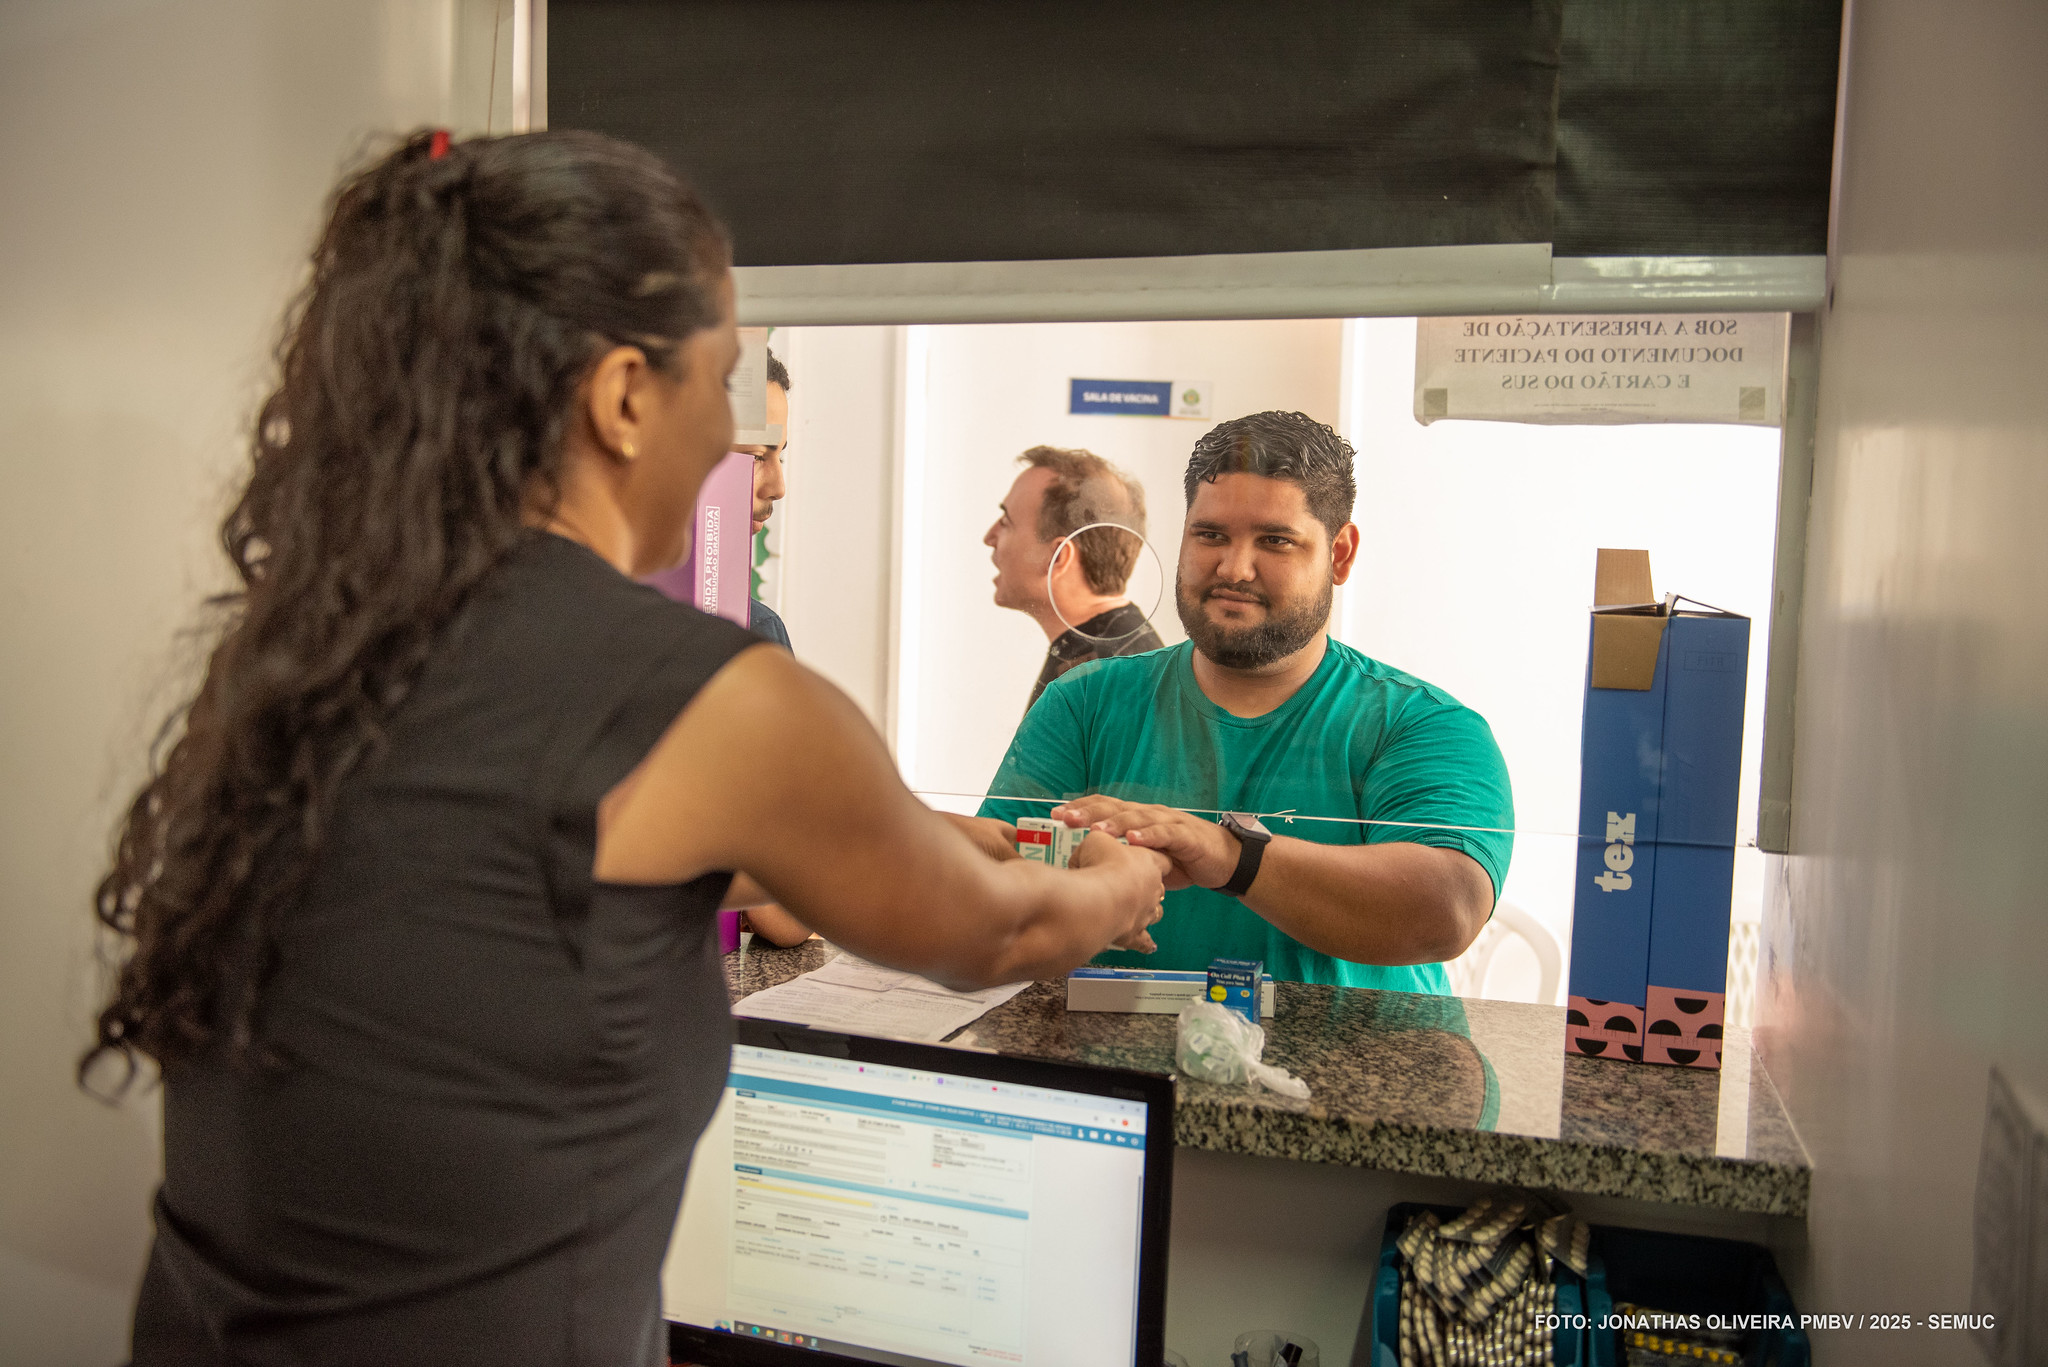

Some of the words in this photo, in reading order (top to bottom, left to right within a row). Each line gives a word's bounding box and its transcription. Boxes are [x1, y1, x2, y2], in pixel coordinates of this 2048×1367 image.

[1083, 392, 1108, 403] SALA
[1108, 392, 1122, 403] DE
[1123, 393, 1159, 405] VACINA
[706, 509, 714, 574] PROIBIDA
[704, 577, 712, 614] ENDA
[1594, 811, 1636, 893] tex
